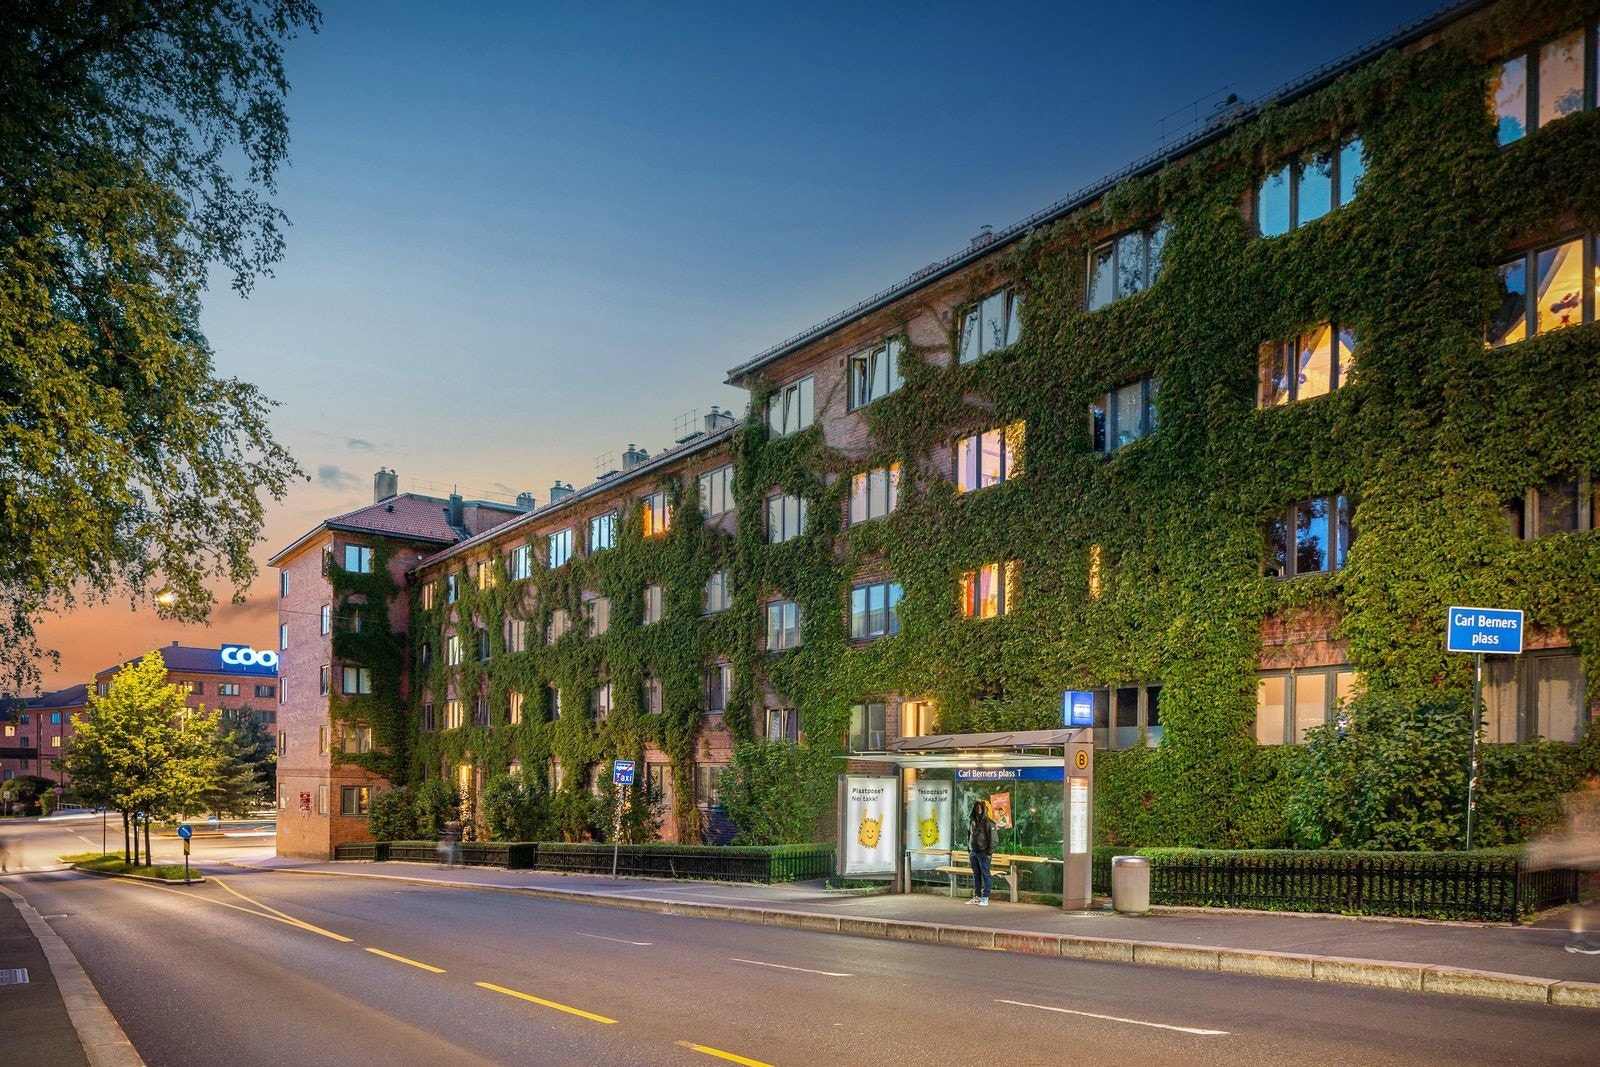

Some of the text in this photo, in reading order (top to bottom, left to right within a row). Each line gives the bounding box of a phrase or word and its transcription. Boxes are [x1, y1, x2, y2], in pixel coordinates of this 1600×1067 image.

[1454, 613, 1517, 629] Carl Berners
[1472, 632, 1499, 646] plass
[221, 647, 279, 671] coo
[1079, 754, 1085, 765] B
[615, 773, 632, 782] Taxi
[958, 769, 1022, 779] Carl Berners plass T
[852, 787, 884, 795] Plastpose?
